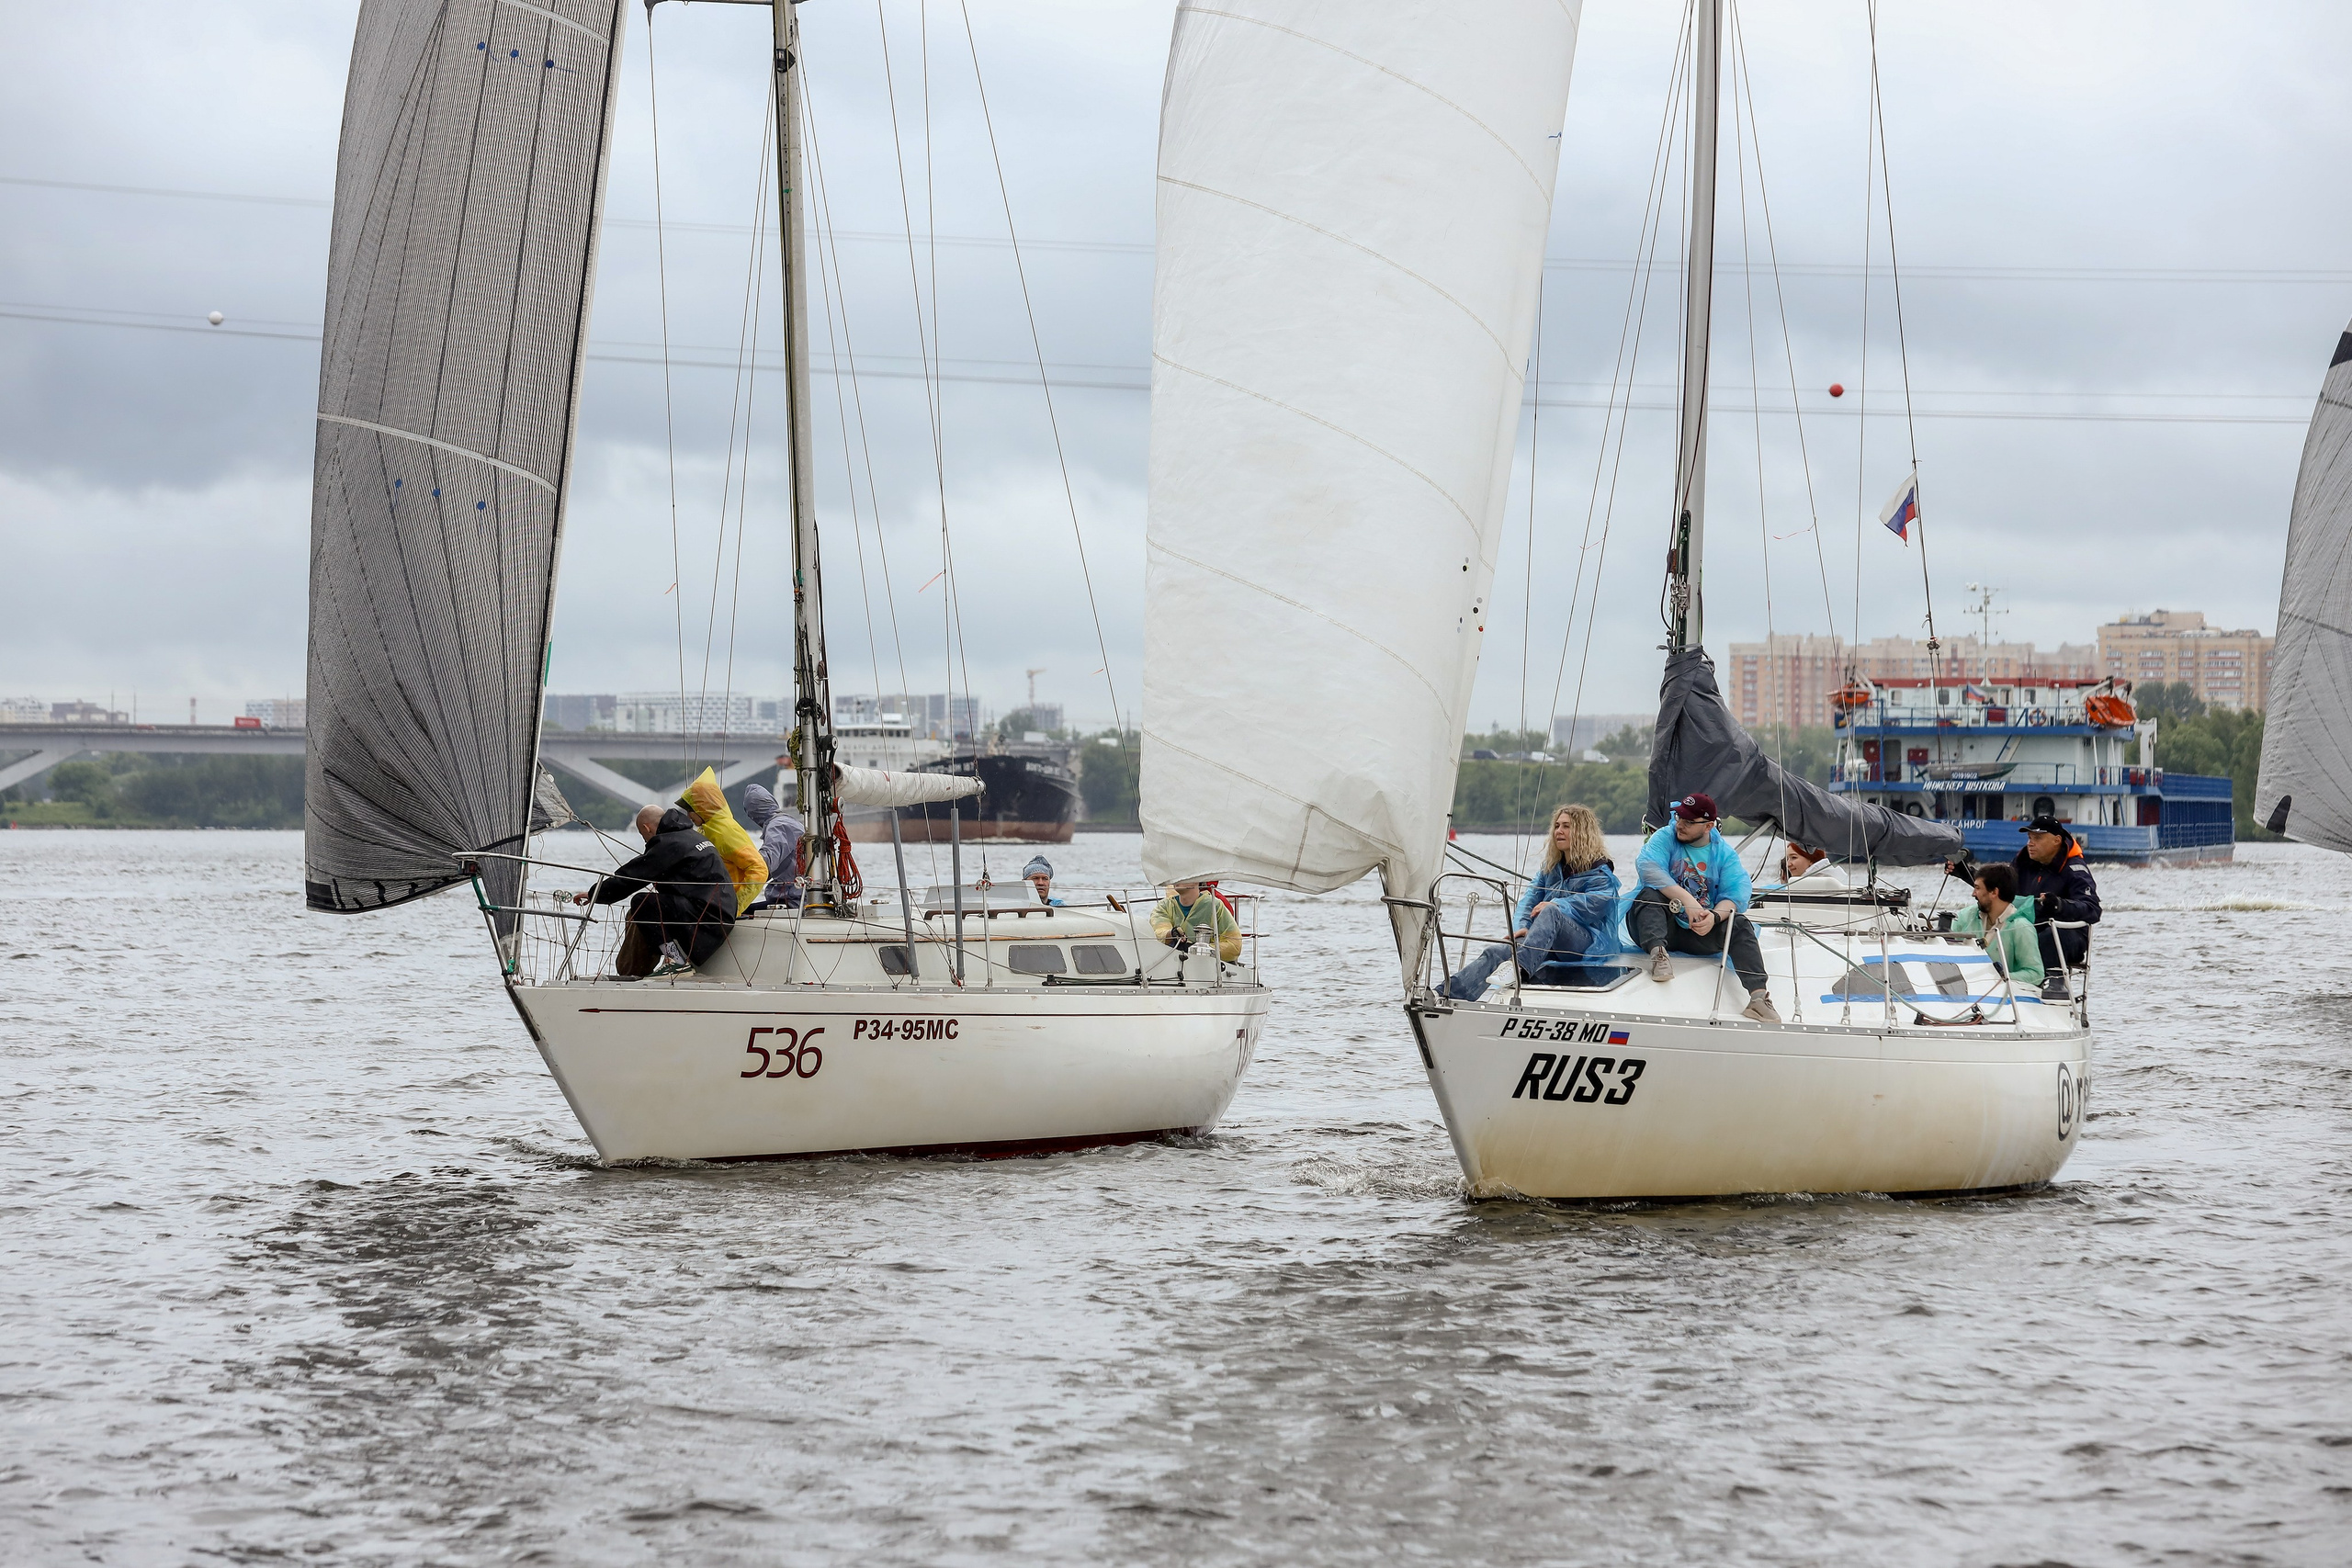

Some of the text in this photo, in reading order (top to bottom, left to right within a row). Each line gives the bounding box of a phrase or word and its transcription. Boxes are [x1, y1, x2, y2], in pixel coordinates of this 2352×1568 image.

[741, 1027, 825, 1078] 536
[1518, 1020, 1578, 1041] 55-38
[1511, 1053, 1646, 1105] RUS3
